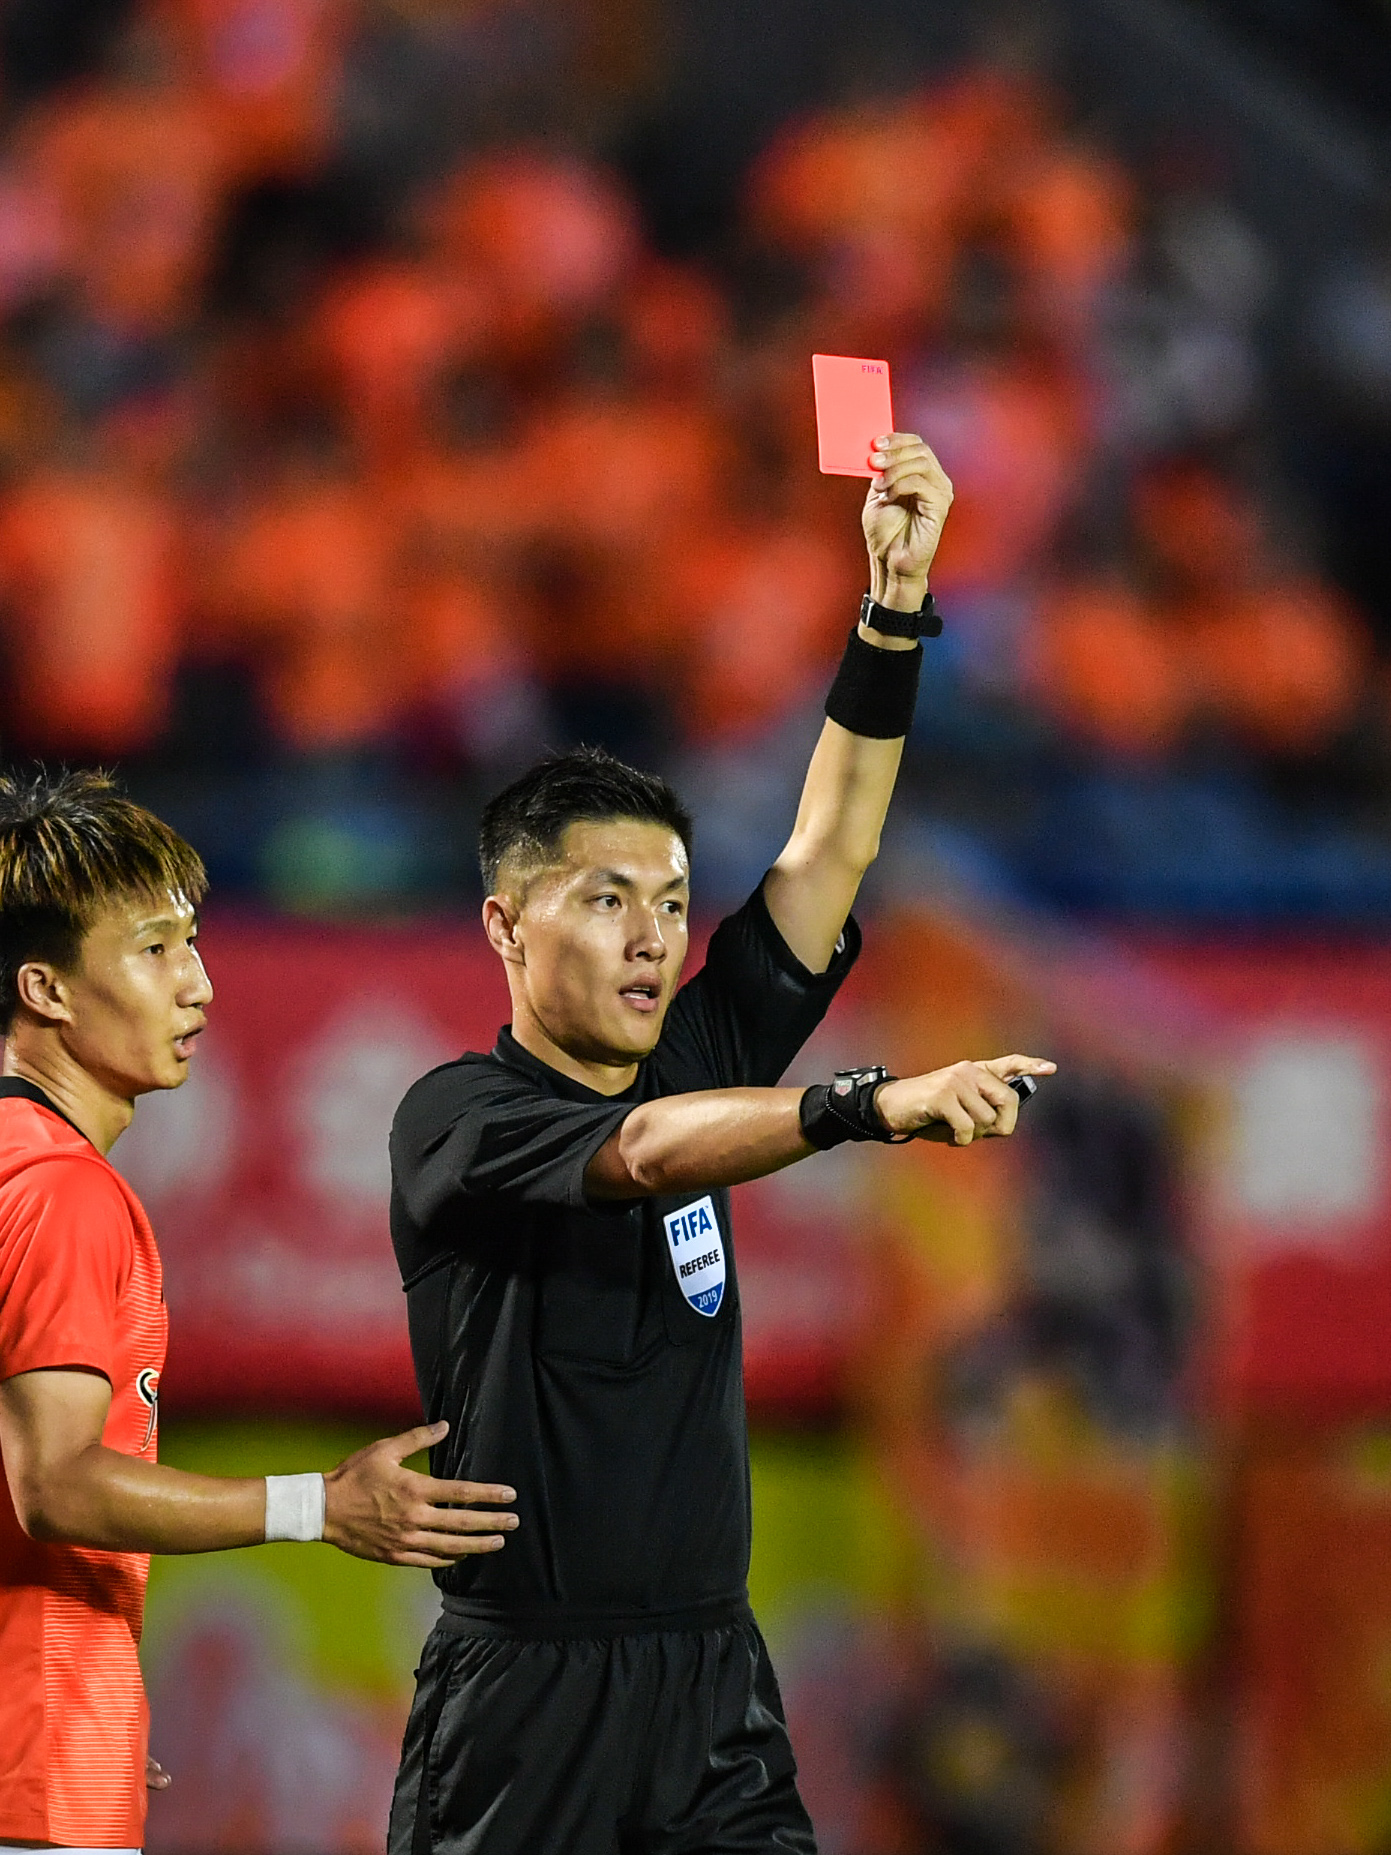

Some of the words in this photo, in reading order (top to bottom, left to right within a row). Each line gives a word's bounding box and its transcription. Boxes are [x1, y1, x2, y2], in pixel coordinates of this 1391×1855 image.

[861, 365, 884, 375] FIFA
[669, 1206, 713, 1247] FIFA
[678, 1248, 721, 1279] REFEREE
[697, 1289, 719, 1309] 2019
